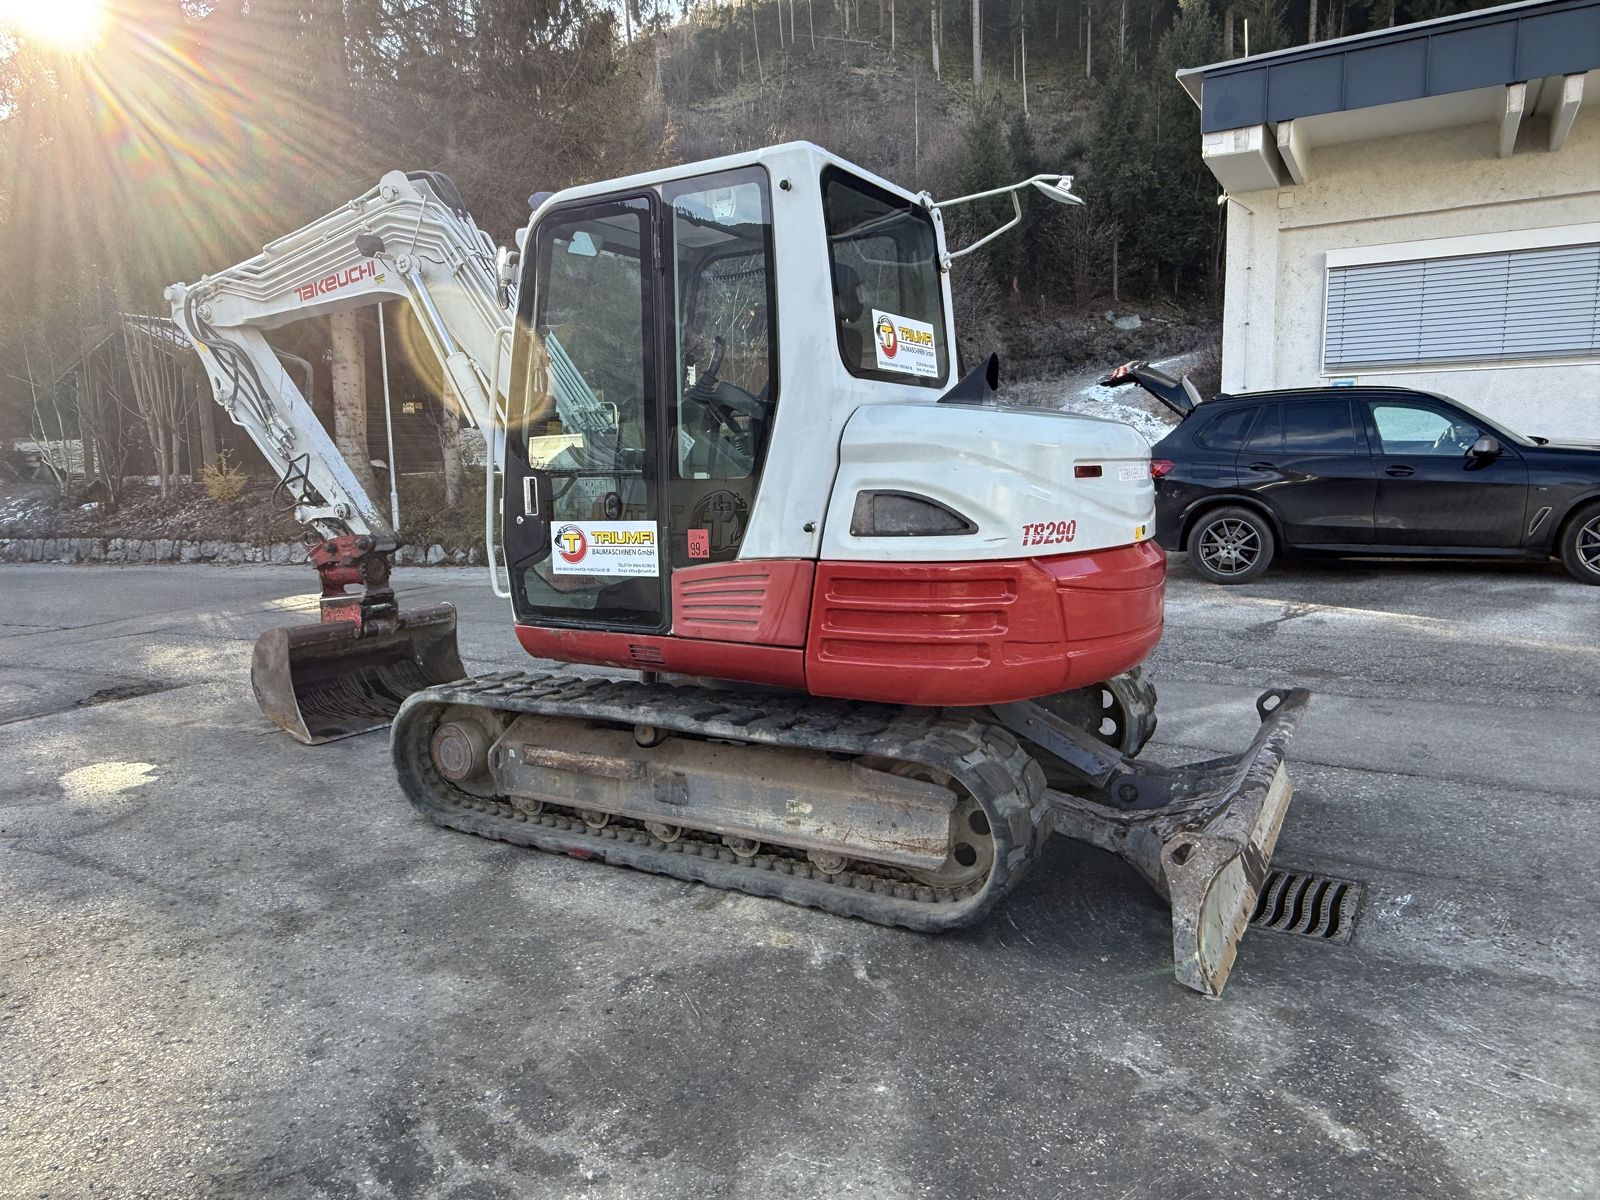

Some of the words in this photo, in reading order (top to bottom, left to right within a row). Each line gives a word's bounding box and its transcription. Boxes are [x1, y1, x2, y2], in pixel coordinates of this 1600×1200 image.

[294, 261, 376, 301] TAKEUCHI
[591, 531, 655, 545] TRIUMFI
[1022, 520, 1077, 546] TB290
[690, 542, 701, 556] 99
